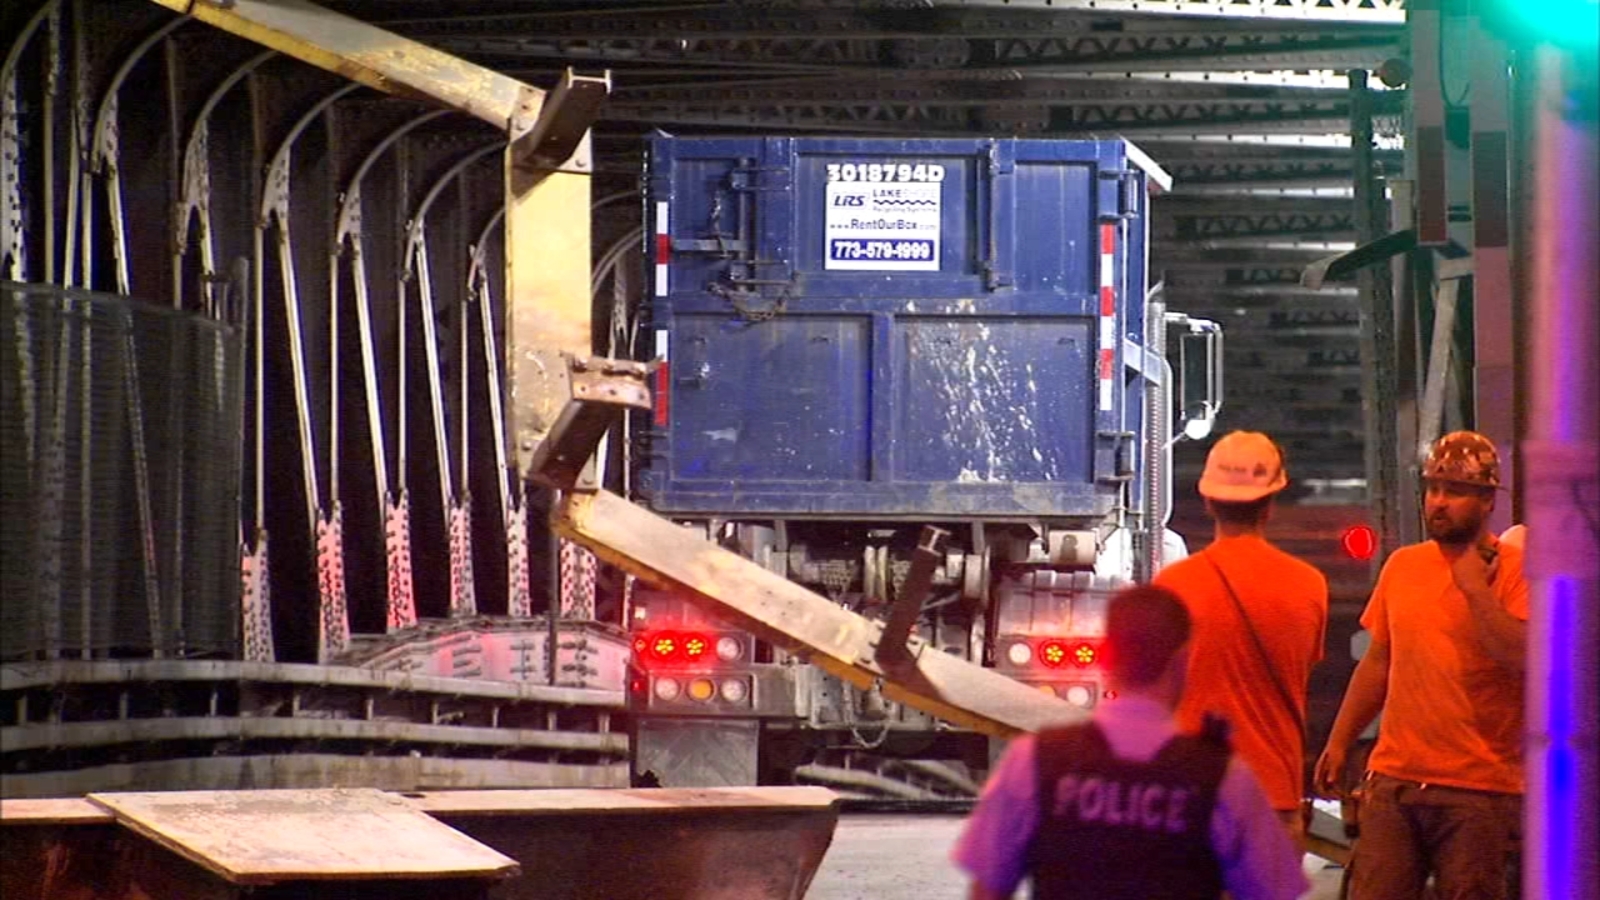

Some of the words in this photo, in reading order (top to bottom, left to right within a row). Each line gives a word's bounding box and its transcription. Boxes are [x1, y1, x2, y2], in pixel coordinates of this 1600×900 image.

[826, 163, 945, 182] 3018794D
[834, 195, 866, 207] LRS
[834, 240, 931, 259] 773-579-1999
[1054, 773, 1189, 833] POLICE
